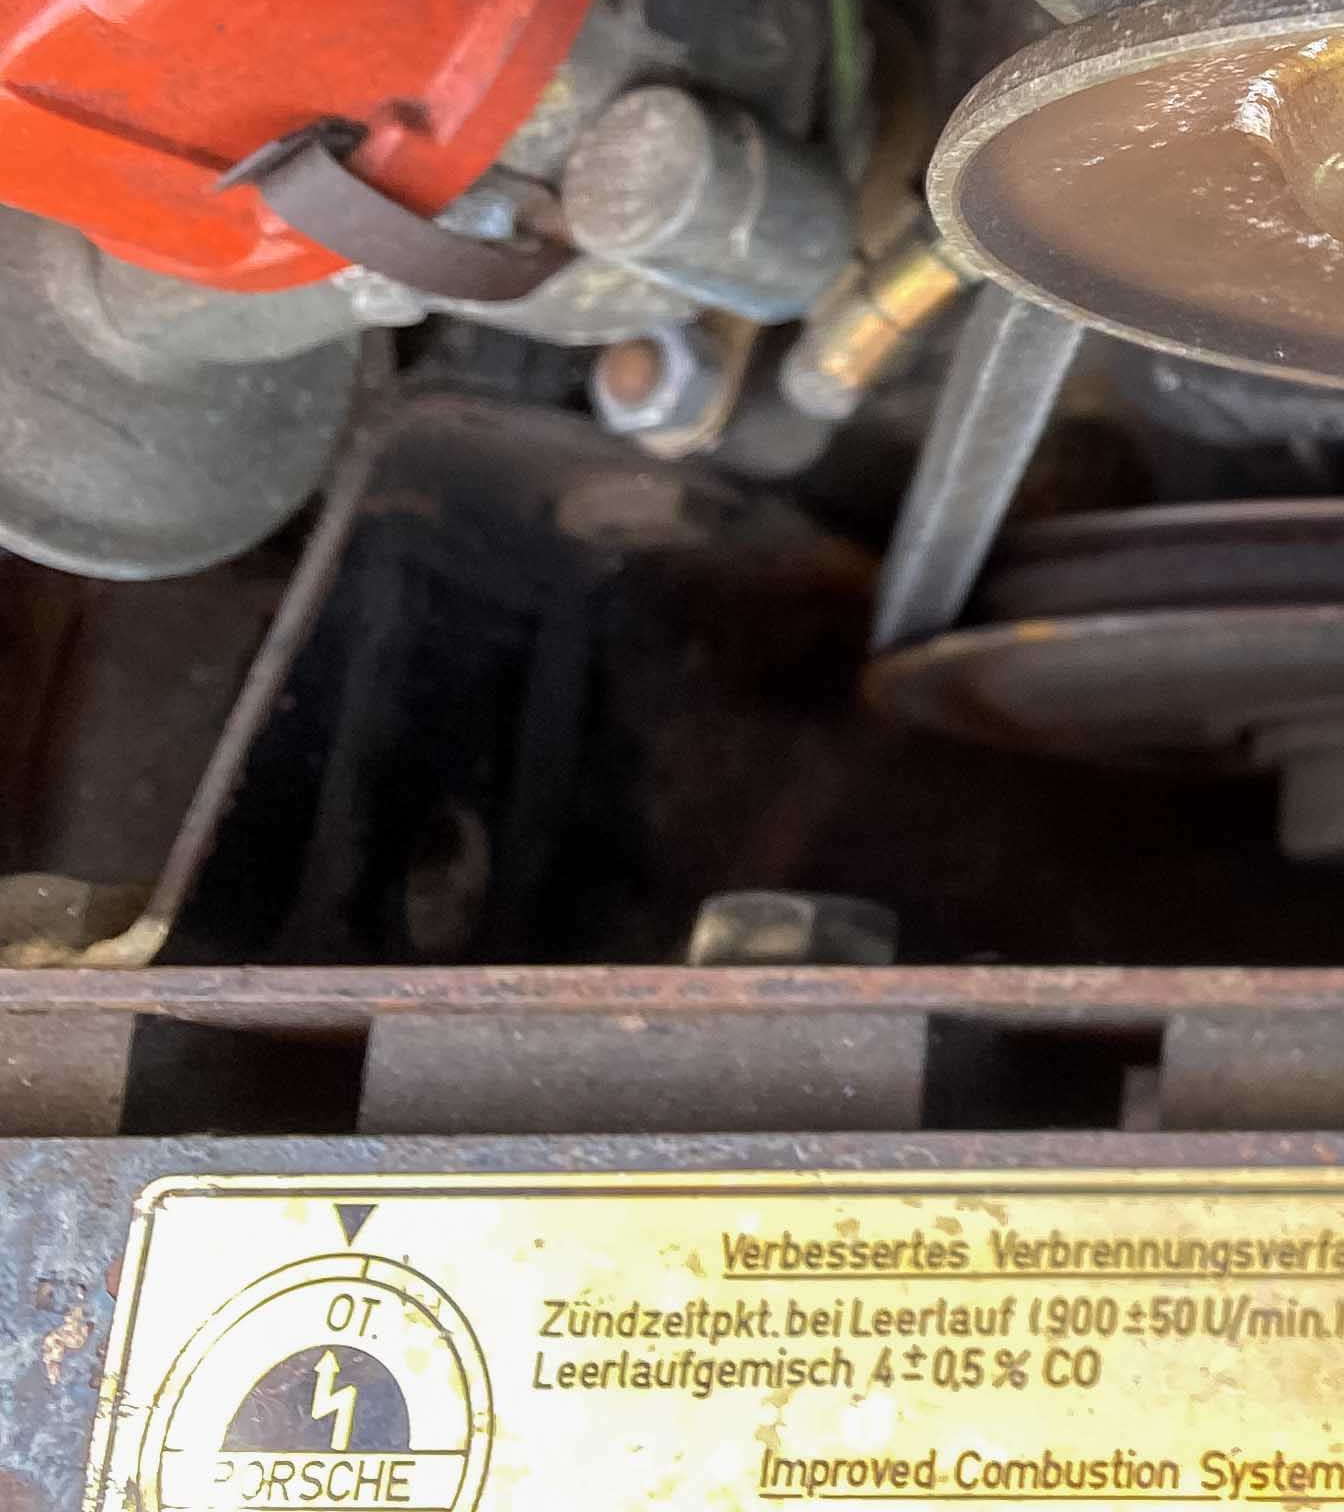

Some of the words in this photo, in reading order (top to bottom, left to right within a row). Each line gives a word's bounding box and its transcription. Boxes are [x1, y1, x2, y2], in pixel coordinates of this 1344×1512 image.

[721, 1230, 970, 1272] Verbessertes
[539, 1297, 779, 1345] Zündzeitpkt.
[785, 1298, 843, 1338] bei
[851, 1296, 1018, 1338] Leerlauf
[532, 1348, 854, 1397] Leerlaufgemisch
[1042, 1345, 1102, 1388] CO
[759, 1448, 938, 1497] Improved
[954, 1449, 1180, 1491] Combustion
